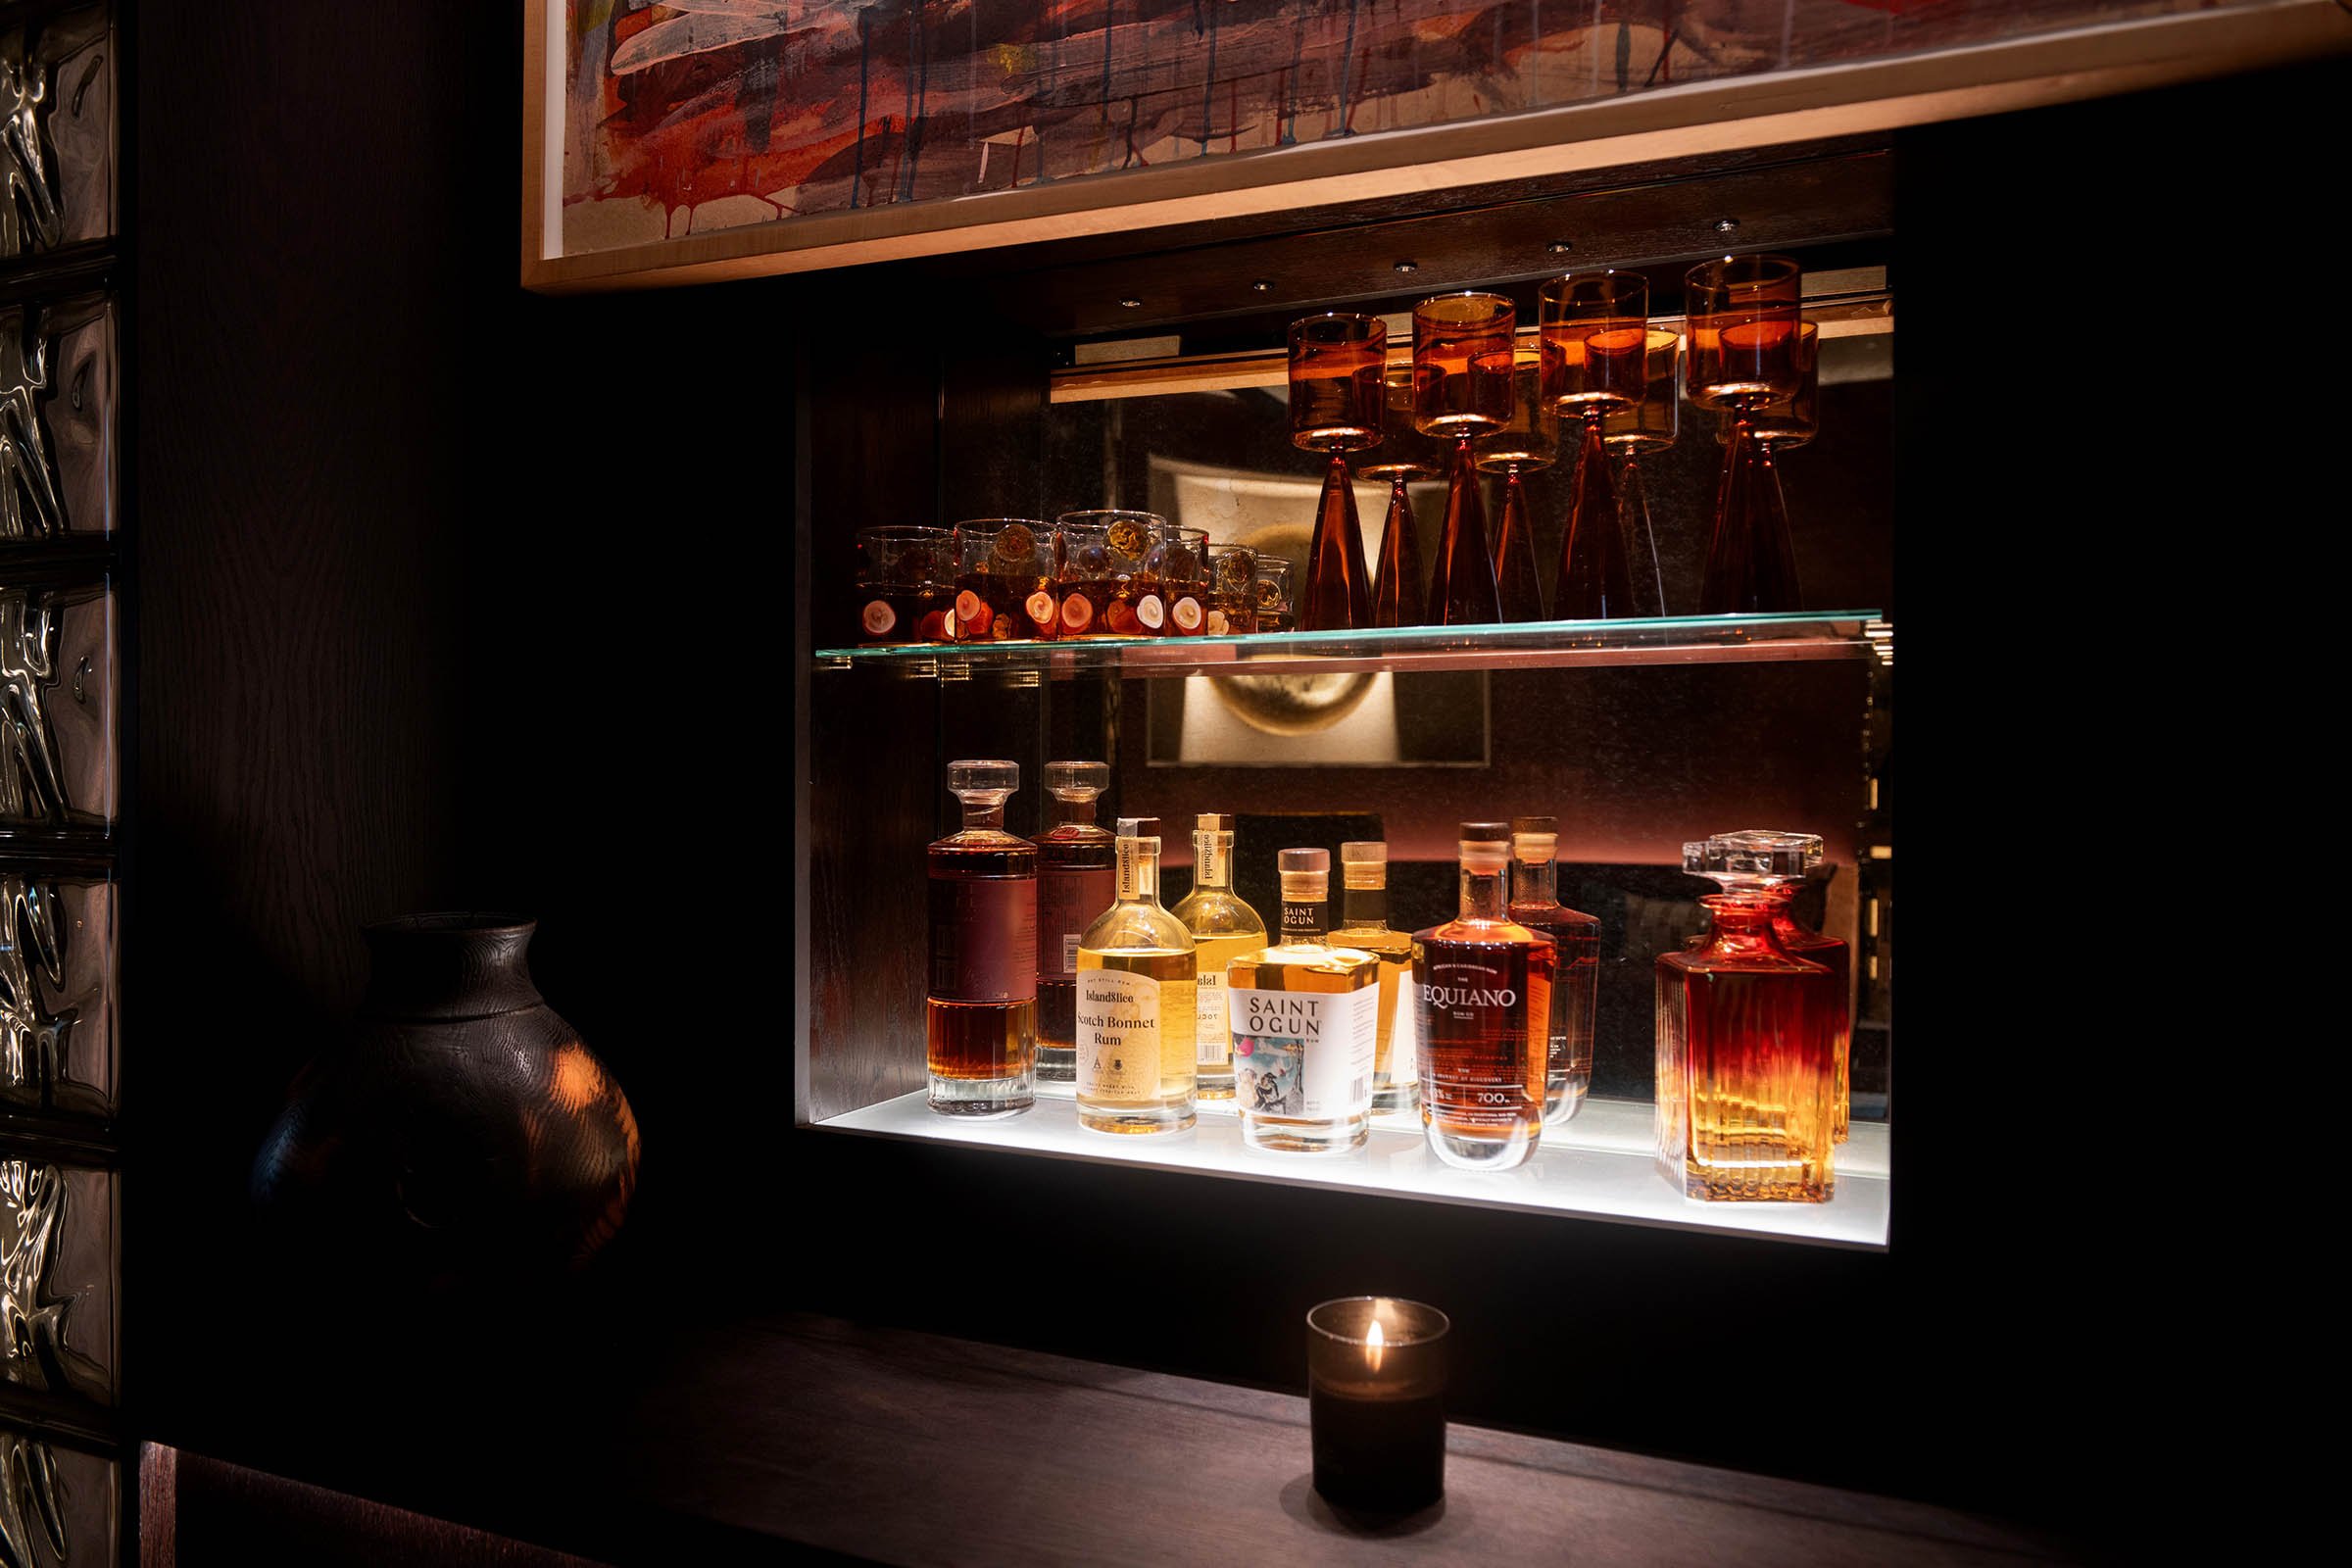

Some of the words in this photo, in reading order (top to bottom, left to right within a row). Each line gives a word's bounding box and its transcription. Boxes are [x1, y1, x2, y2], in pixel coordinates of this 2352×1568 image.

[1284, 906, 1314, 916] SAINT
[1284, 915, 1314, 925] OGUN
[1423, 984, 1516, 1009] EQUIANO
[1250, 997, 1319, 1017] SAINT
[1107, 1015, 1155, 1029] Bonnet
[1250, 1015, 1320, 1036] OGUN
[1095, 1032, 1121, 1046] Rum
